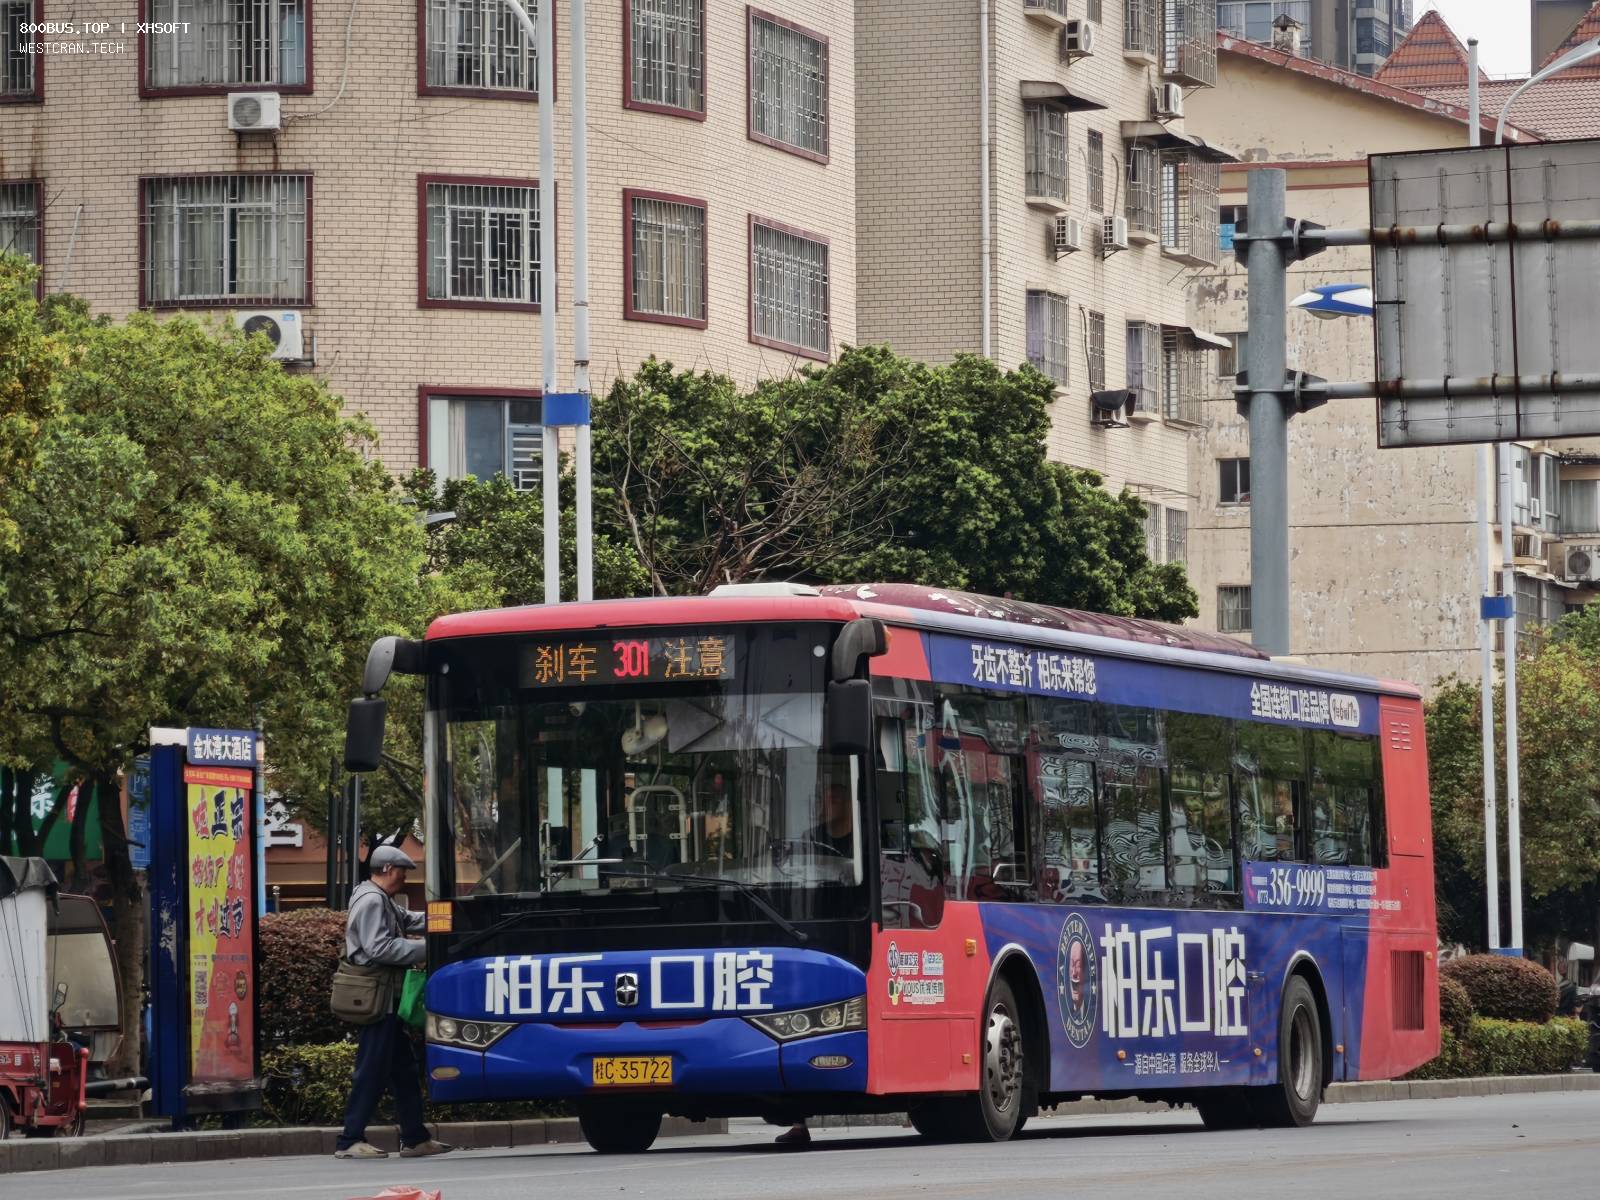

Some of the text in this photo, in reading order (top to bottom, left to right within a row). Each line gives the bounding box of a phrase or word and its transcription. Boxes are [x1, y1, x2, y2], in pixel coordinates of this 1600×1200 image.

[535, 636, 727, 683] 刹车 301 注意
[971, 643, 1097, 695] 牙齿不整齐 柏乐来帮您
[1269, 867, 1325, 907] 356-9999
[484, 950, 774, 1015] 柏乐 口腔
[1100, 922, 1249, 1038] 柏乐口腔
